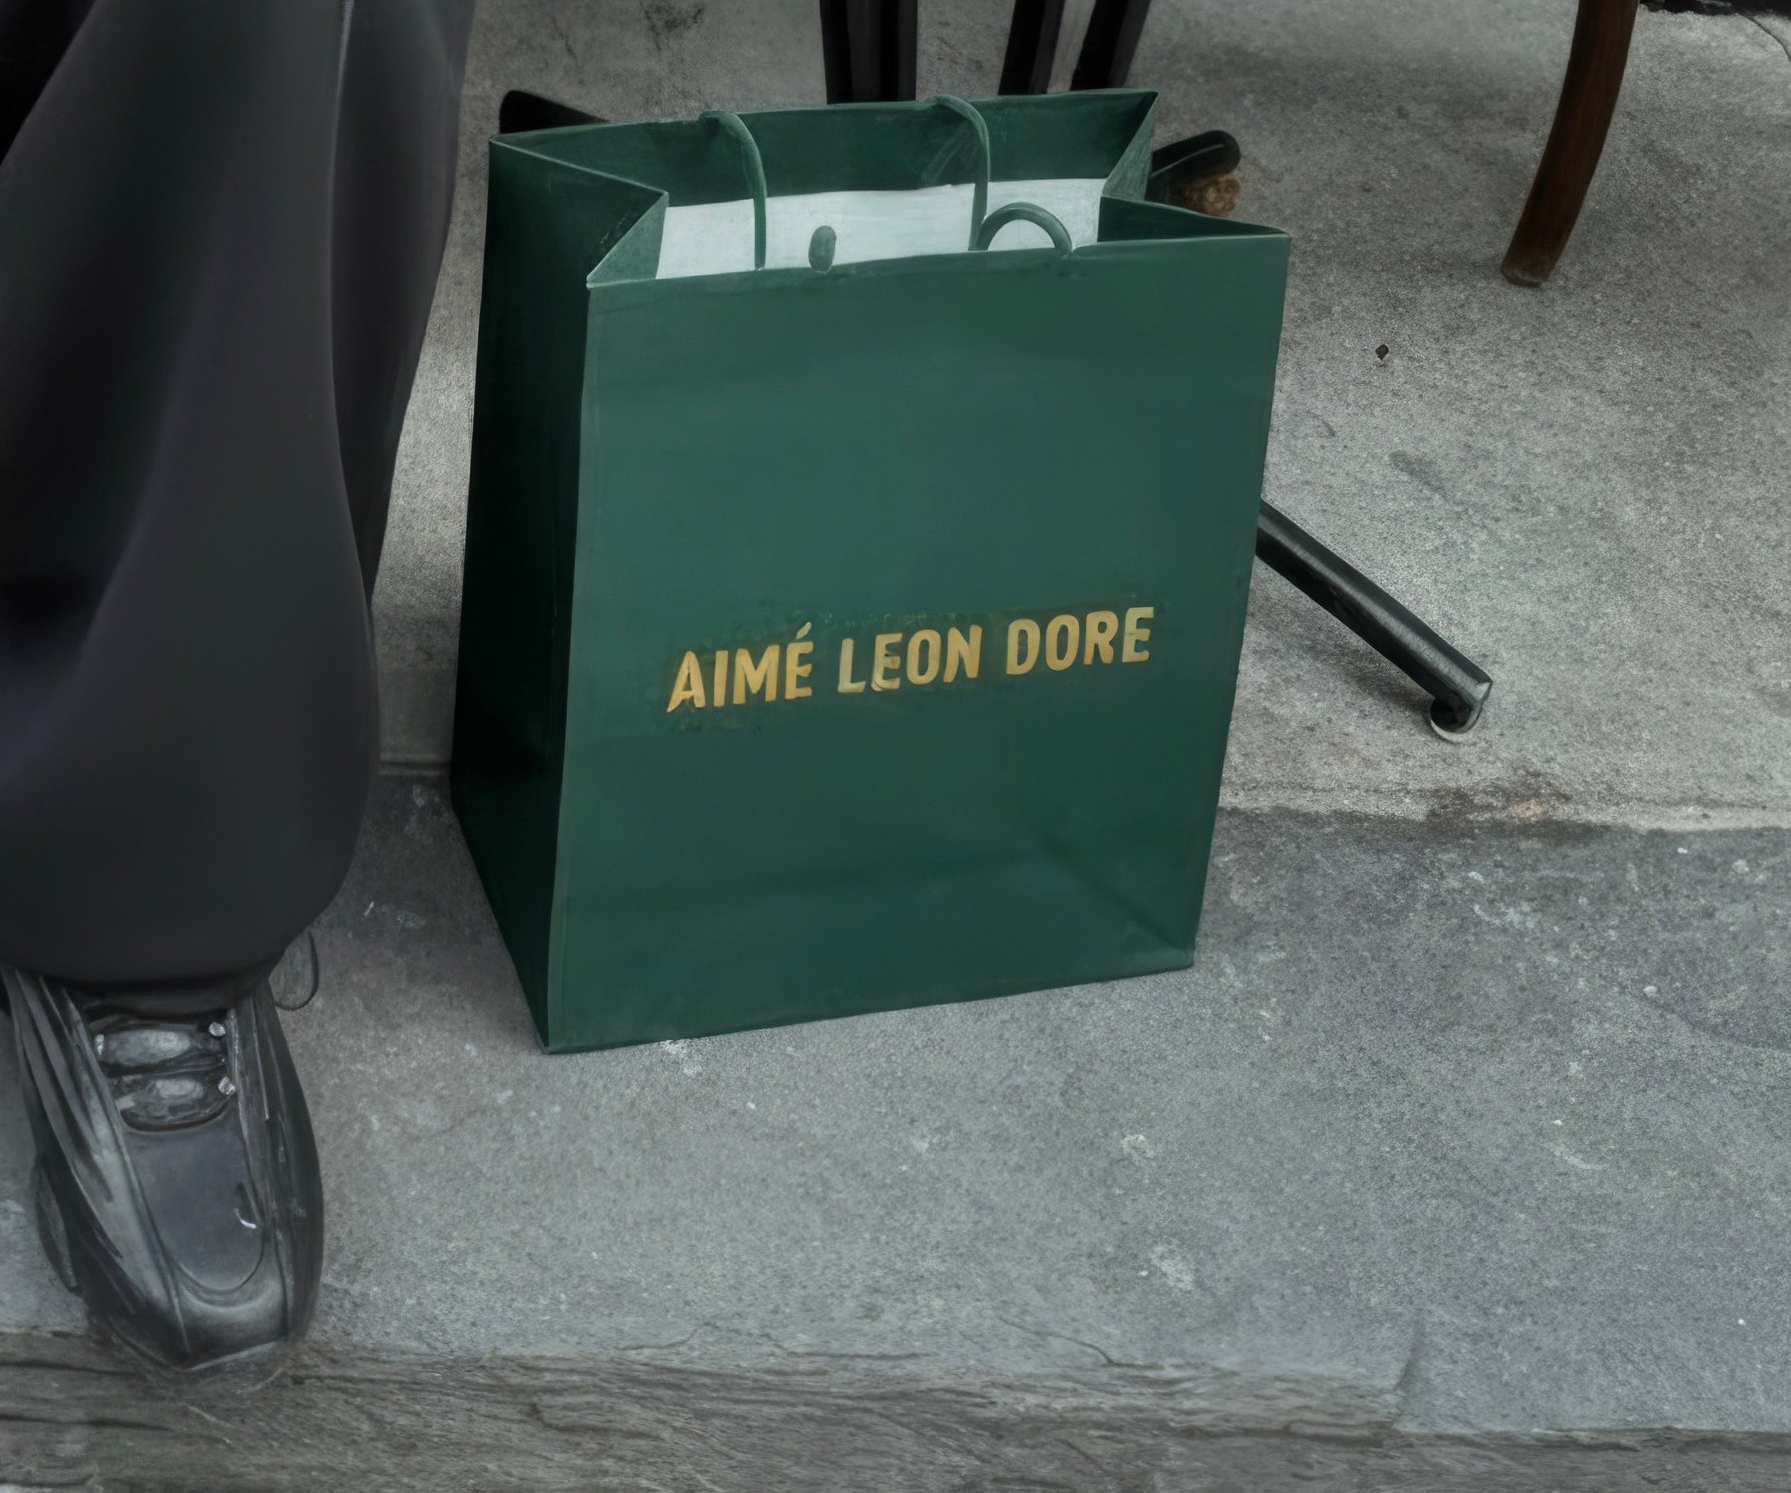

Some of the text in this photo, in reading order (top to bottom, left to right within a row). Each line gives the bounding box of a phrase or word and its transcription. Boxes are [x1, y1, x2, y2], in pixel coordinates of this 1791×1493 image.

[665, 605, 1156, 713] AIMÉ LEON DORE
